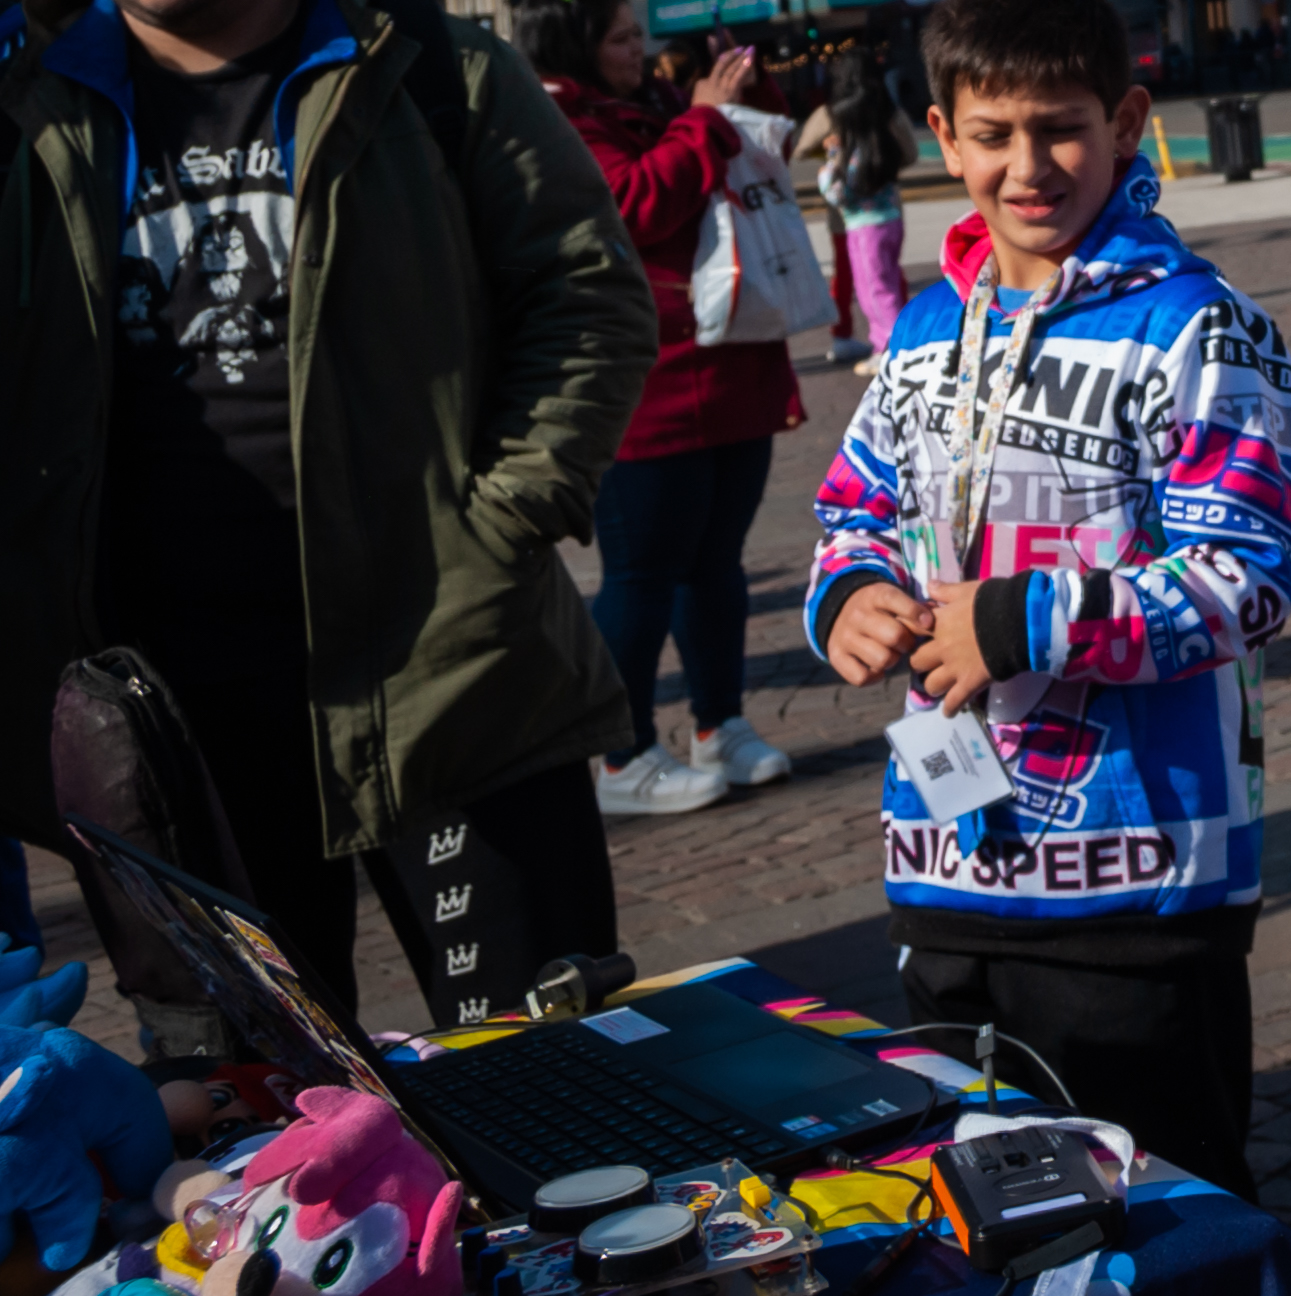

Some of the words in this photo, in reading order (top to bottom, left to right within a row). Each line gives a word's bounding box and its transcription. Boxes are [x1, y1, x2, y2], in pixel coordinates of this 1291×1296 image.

[1002, 417, 1136, 474] EDGEHOG
[1025, 475, 1074, 522] IT
[883, 822, 961, 881] NIC
[971, 831, 1178, 892] SPEED
